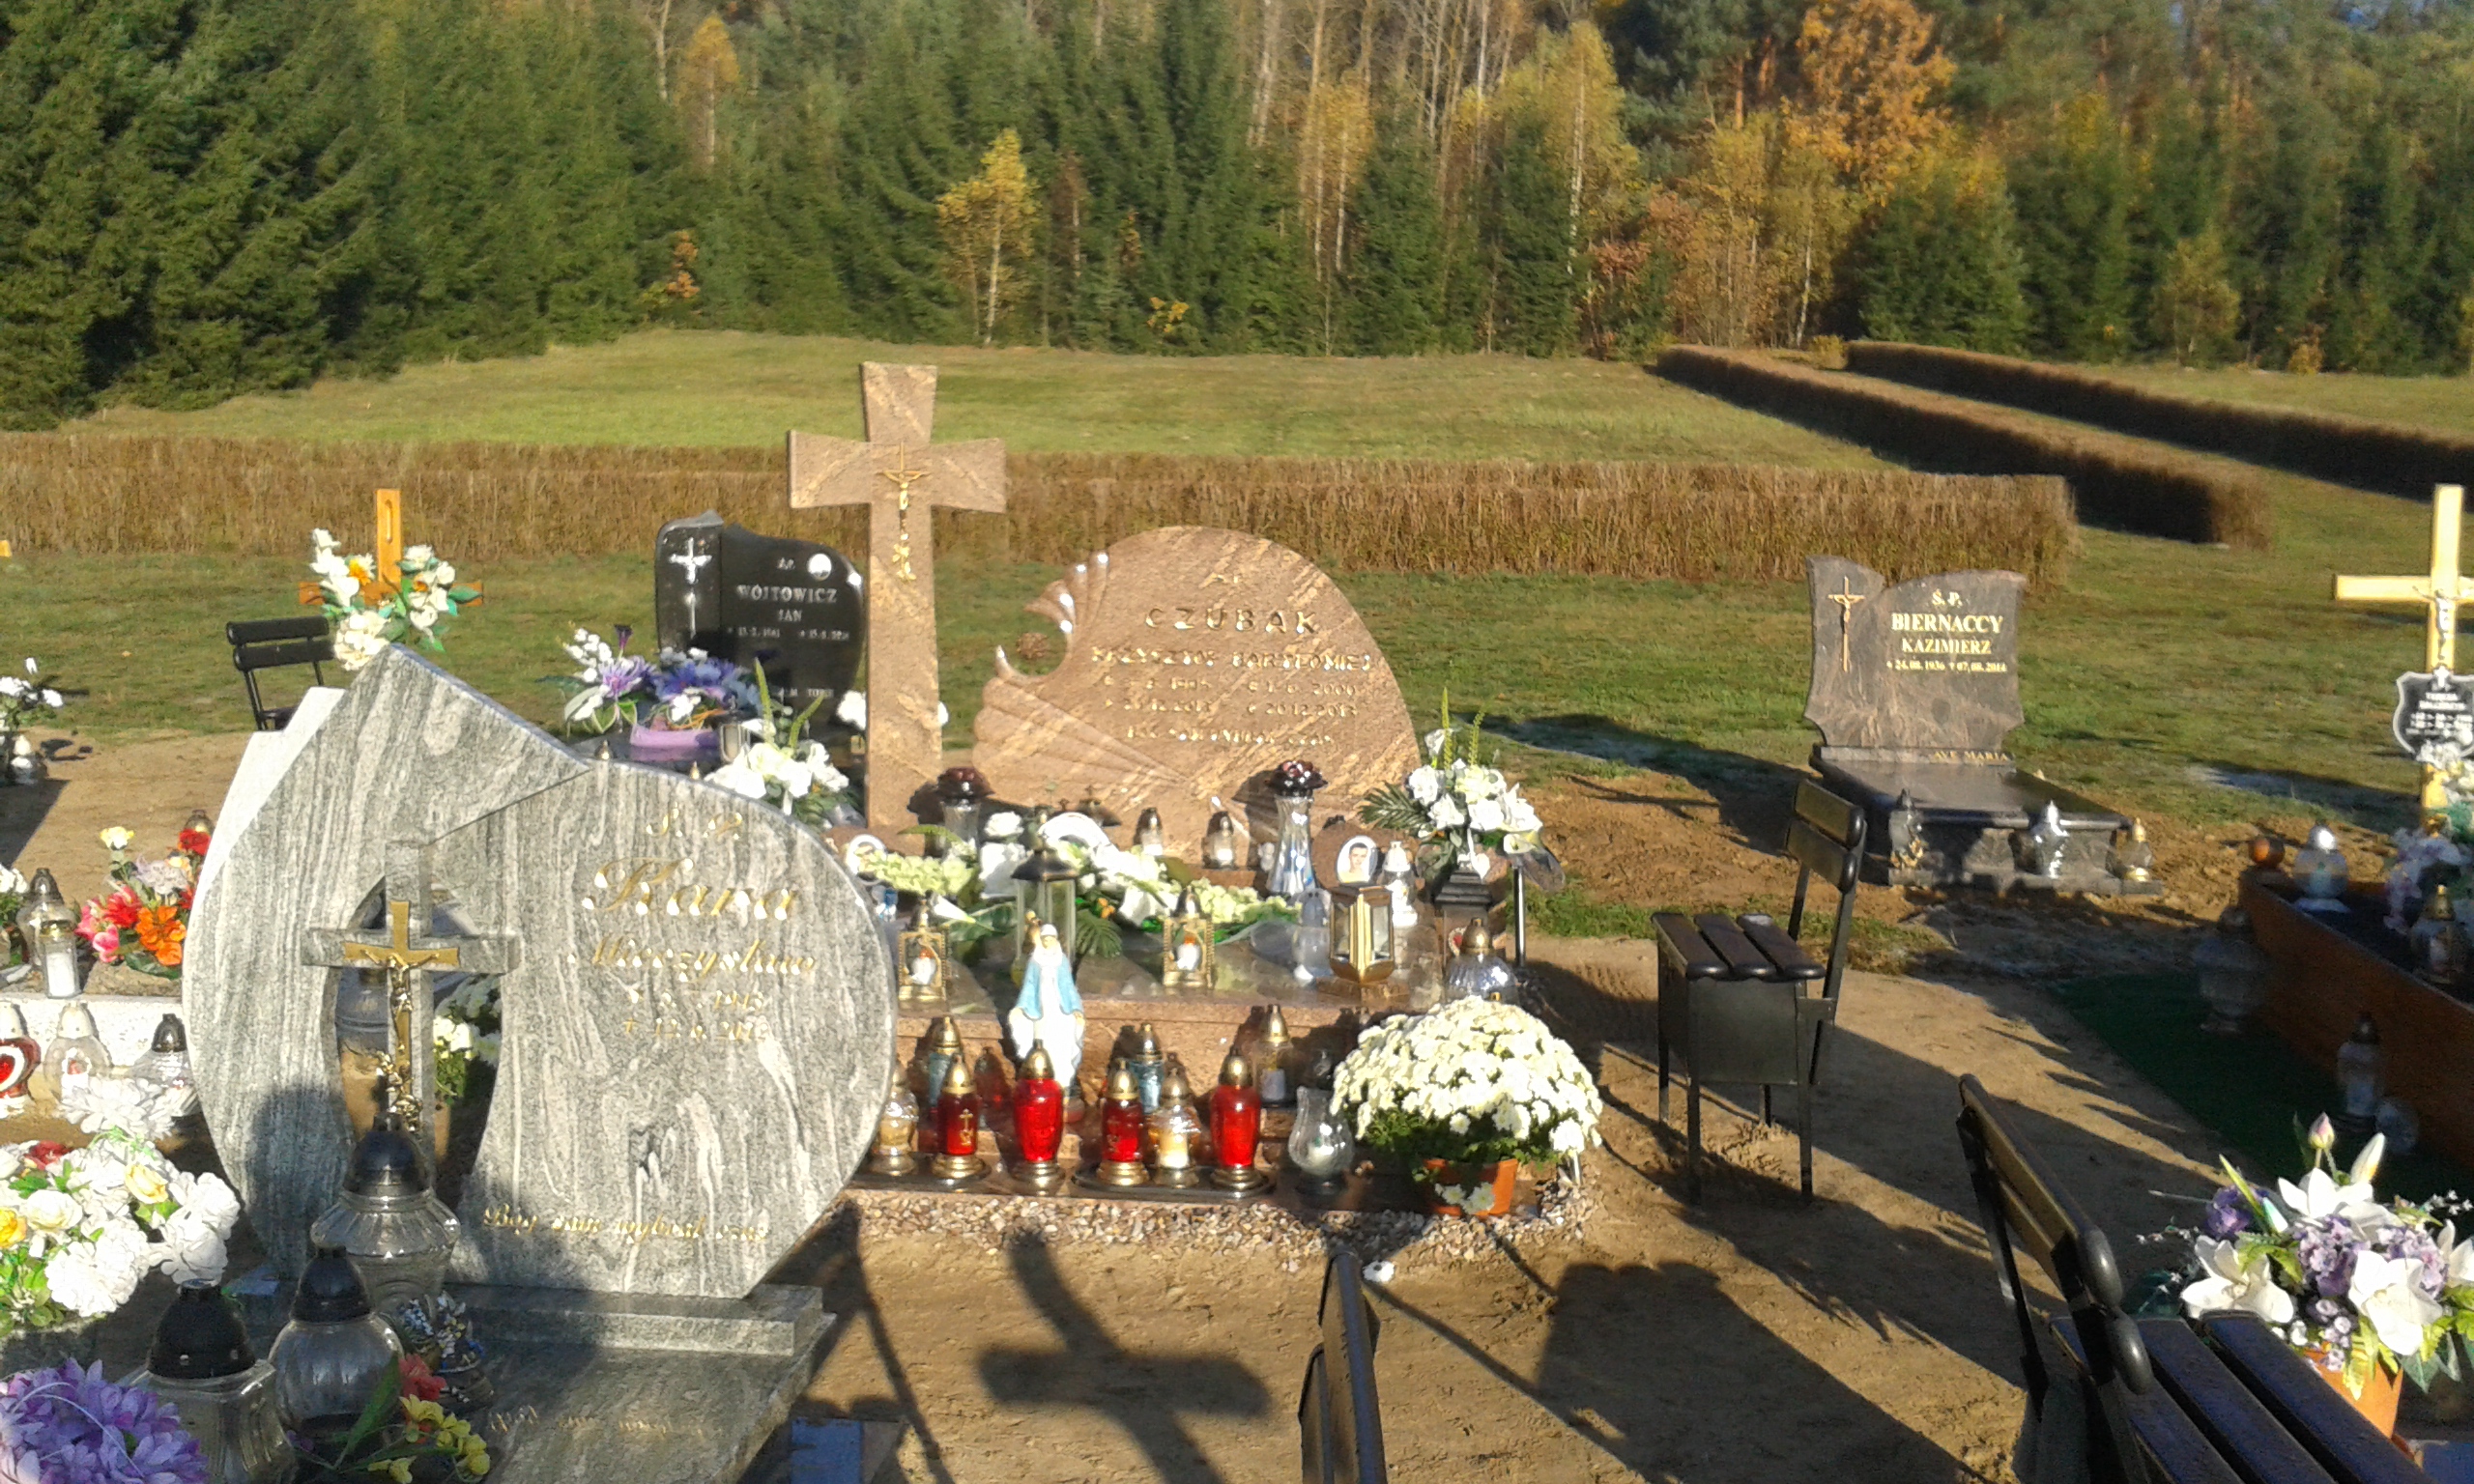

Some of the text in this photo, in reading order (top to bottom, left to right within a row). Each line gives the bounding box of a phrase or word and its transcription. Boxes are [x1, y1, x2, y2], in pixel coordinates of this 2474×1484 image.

[778, 609, 803, 622] JAN
[1146, 608, 1319, 634] CZUBAK
[1891, 613, 2003, 634] BIERNACCY
[1902, 638, 1992, 654] KAZIMIERZ
[1232, 651, 1370, 671] BARTŁOMIEJ
[1964, 751, 2008, 761] MARIA
